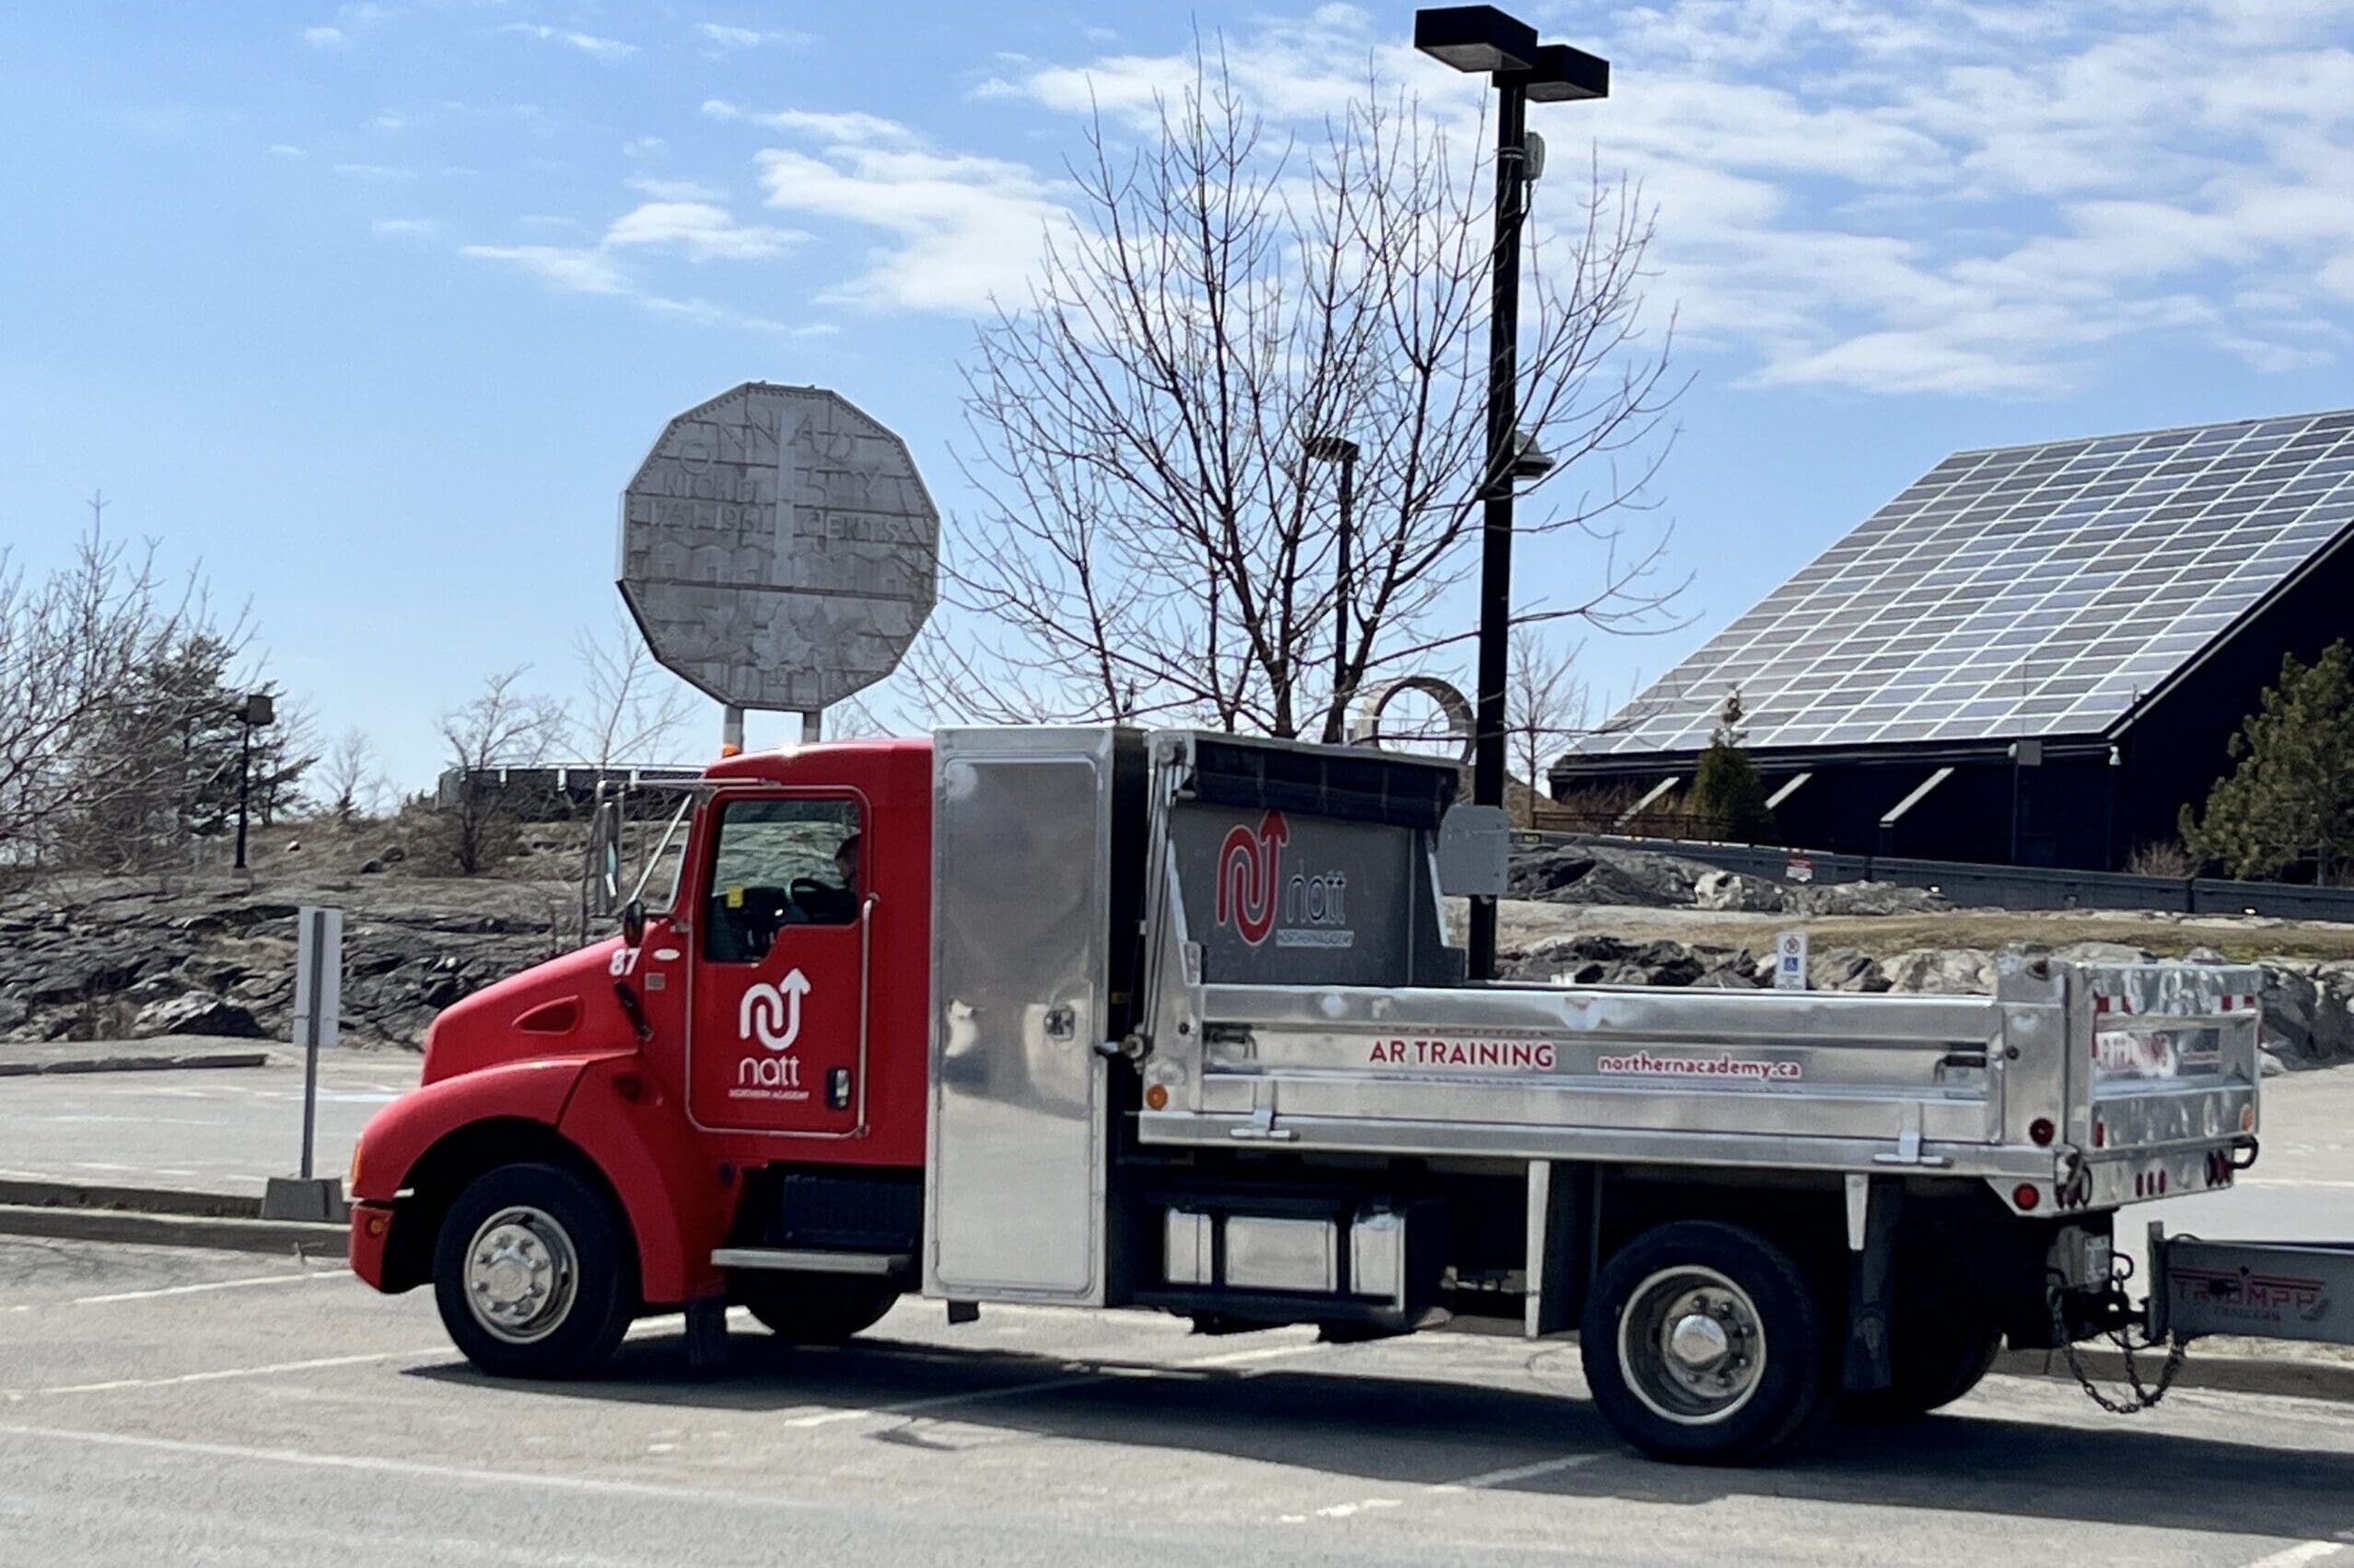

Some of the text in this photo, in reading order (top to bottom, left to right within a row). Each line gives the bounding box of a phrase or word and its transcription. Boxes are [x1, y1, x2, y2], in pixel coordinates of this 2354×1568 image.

[608, 947, 642, 976] 87
[1369, 1040, 1554, 1069] AR TRAINING
[1598, 1052, 1800, 1080] northernacademy.ca
